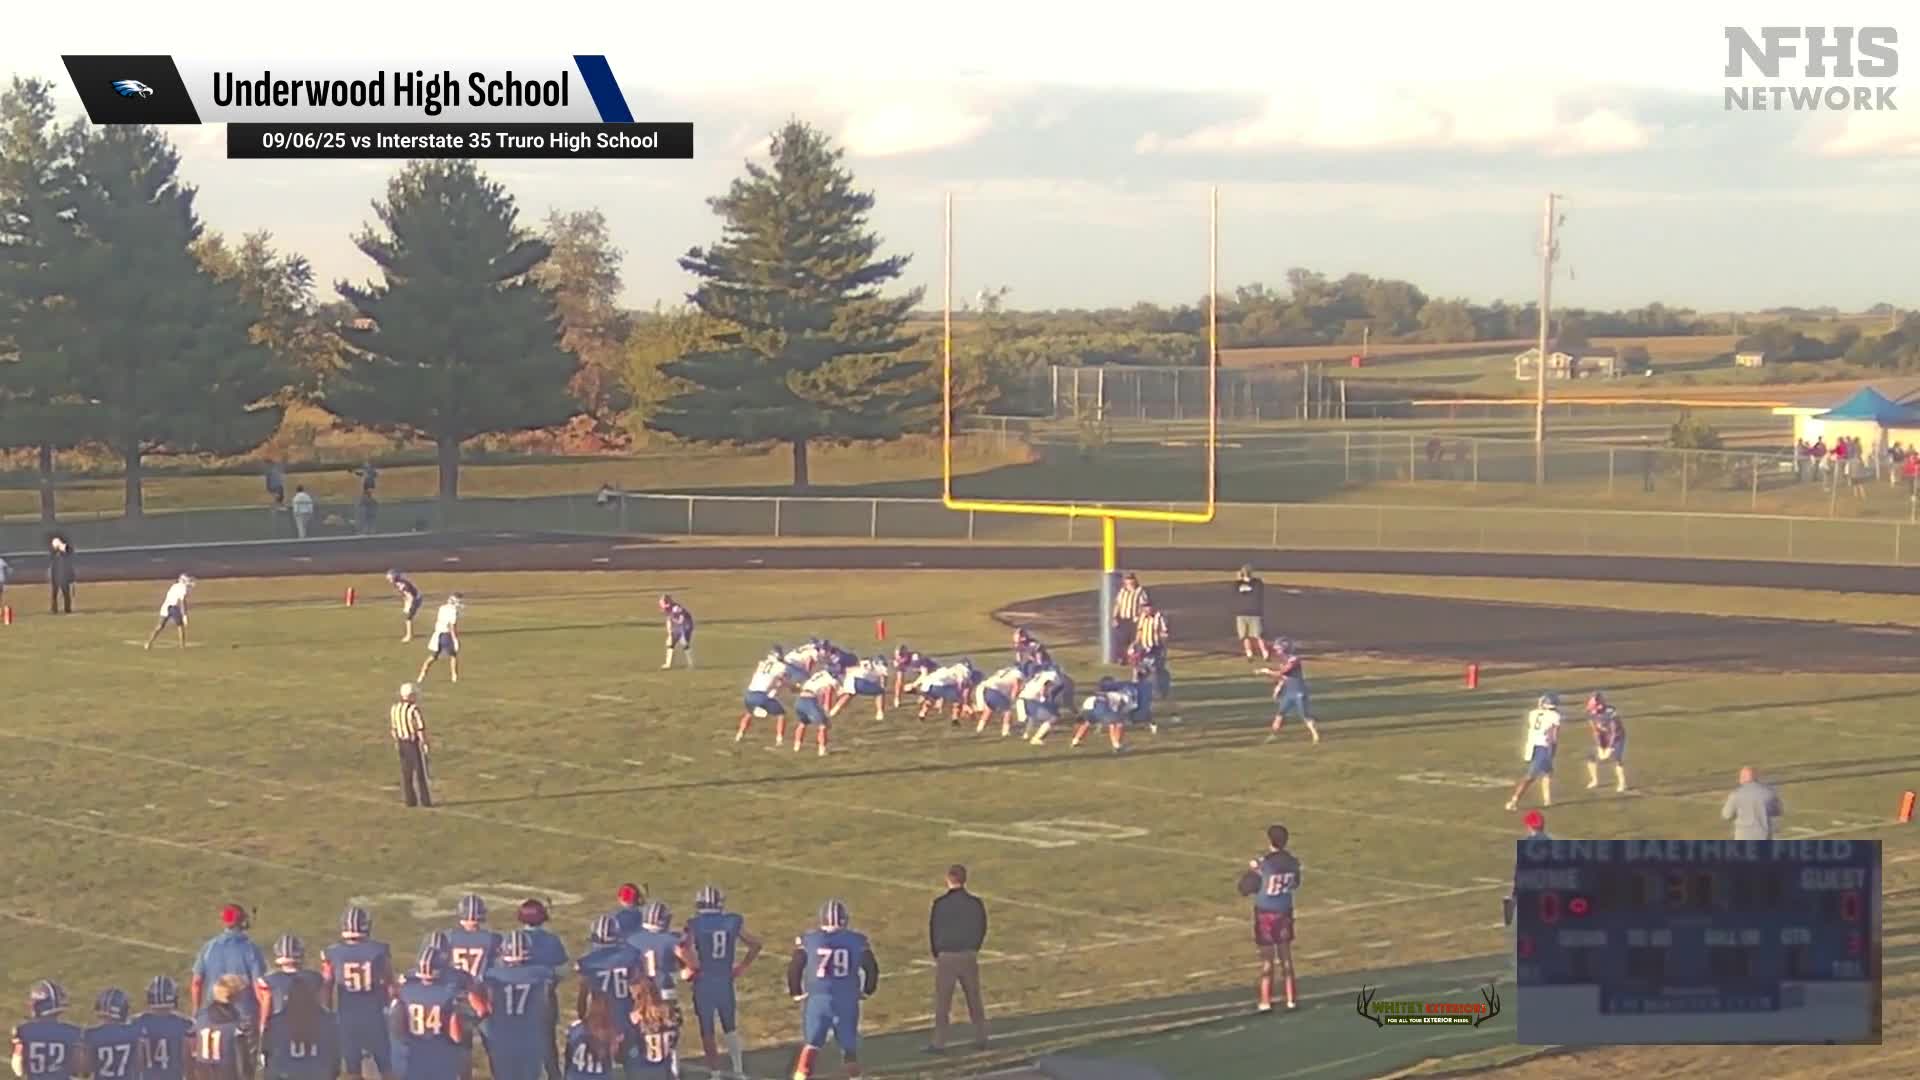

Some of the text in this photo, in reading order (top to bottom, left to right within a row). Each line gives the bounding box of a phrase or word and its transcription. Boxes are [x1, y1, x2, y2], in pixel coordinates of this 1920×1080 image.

[1524, 840, 1612, 861] GENE
[1772, 840, 1853, 861] FIELD
[711, 929, 727, 959] 8
[343, 961, 372, 993] 51
[452, 947, 484, 977] 57
[816, 948, 849, 978] 79
[596, 966, 629, 999] 76
[503, 983, 531, 1016] 17
[408, 1002, 442, 1036] 84
[29, 1041, 65, 1073] 52
[97, 1043, 131, 1077] 27
